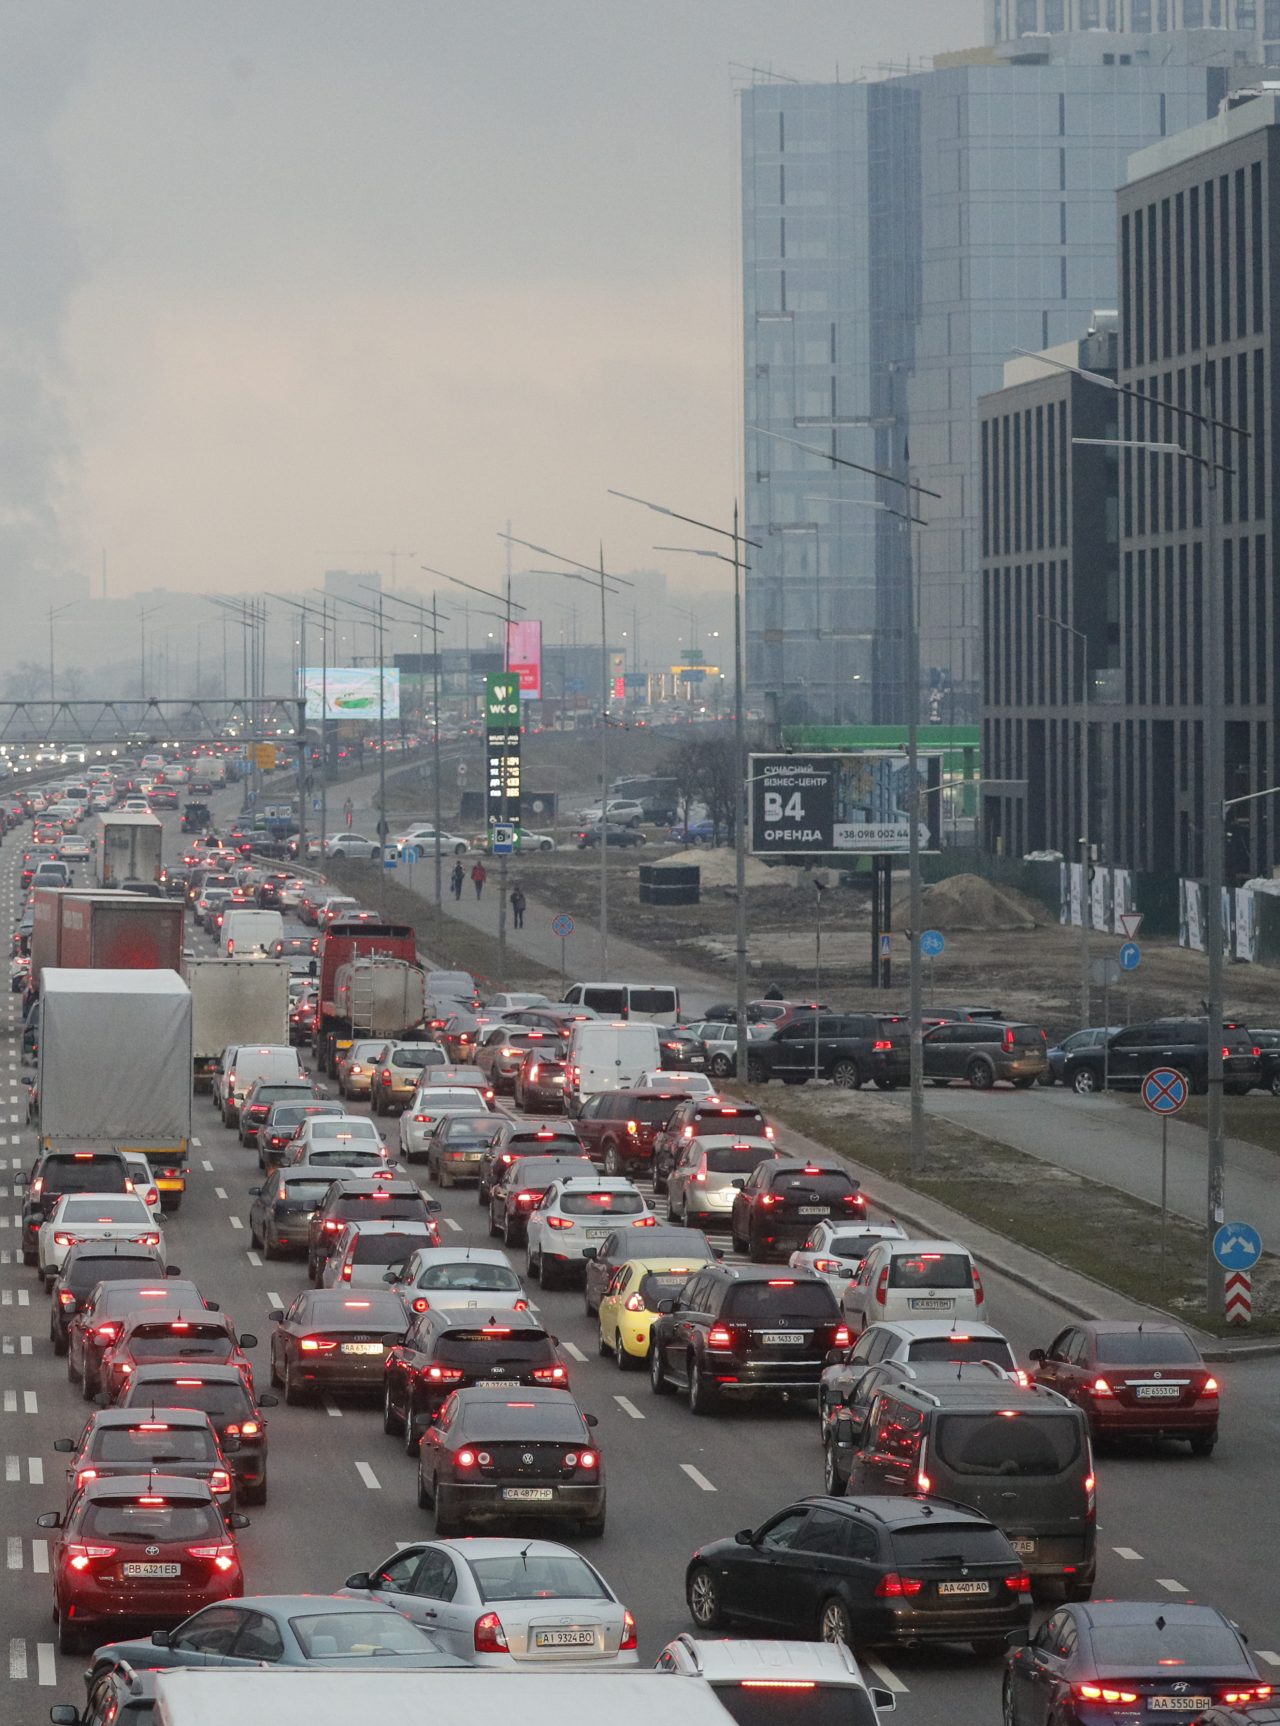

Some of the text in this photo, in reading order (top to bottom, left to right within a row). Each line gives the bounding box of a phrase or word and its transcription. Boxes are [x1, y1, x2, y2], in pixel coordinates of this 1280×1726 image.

[764, 778, 828, 788] БІЗНЕС-ЦЕНТР
[764, 792, 806, 821] B4
[764, 830, 823, 841] ОРЕНДА
[839, 830, 855, 839] +38
[858, 830, 875, 839] 098
[877, 830, 895, 839] 002
[1140, 1387, 1150, 1395] AE
[507, 1489, 552, 1498] CA 4877 HP
[128, 1564, 178, 1574] BB 4321 EB
[943, 1583, 955, 1592] AA
[956, 1583, 975, 1592] 4401
[557, 1633, 577, 1643] 9324
[578, 1632, 592, 1642] BO
[1153, 1698, 1210, 1709] AA 5550 BH
